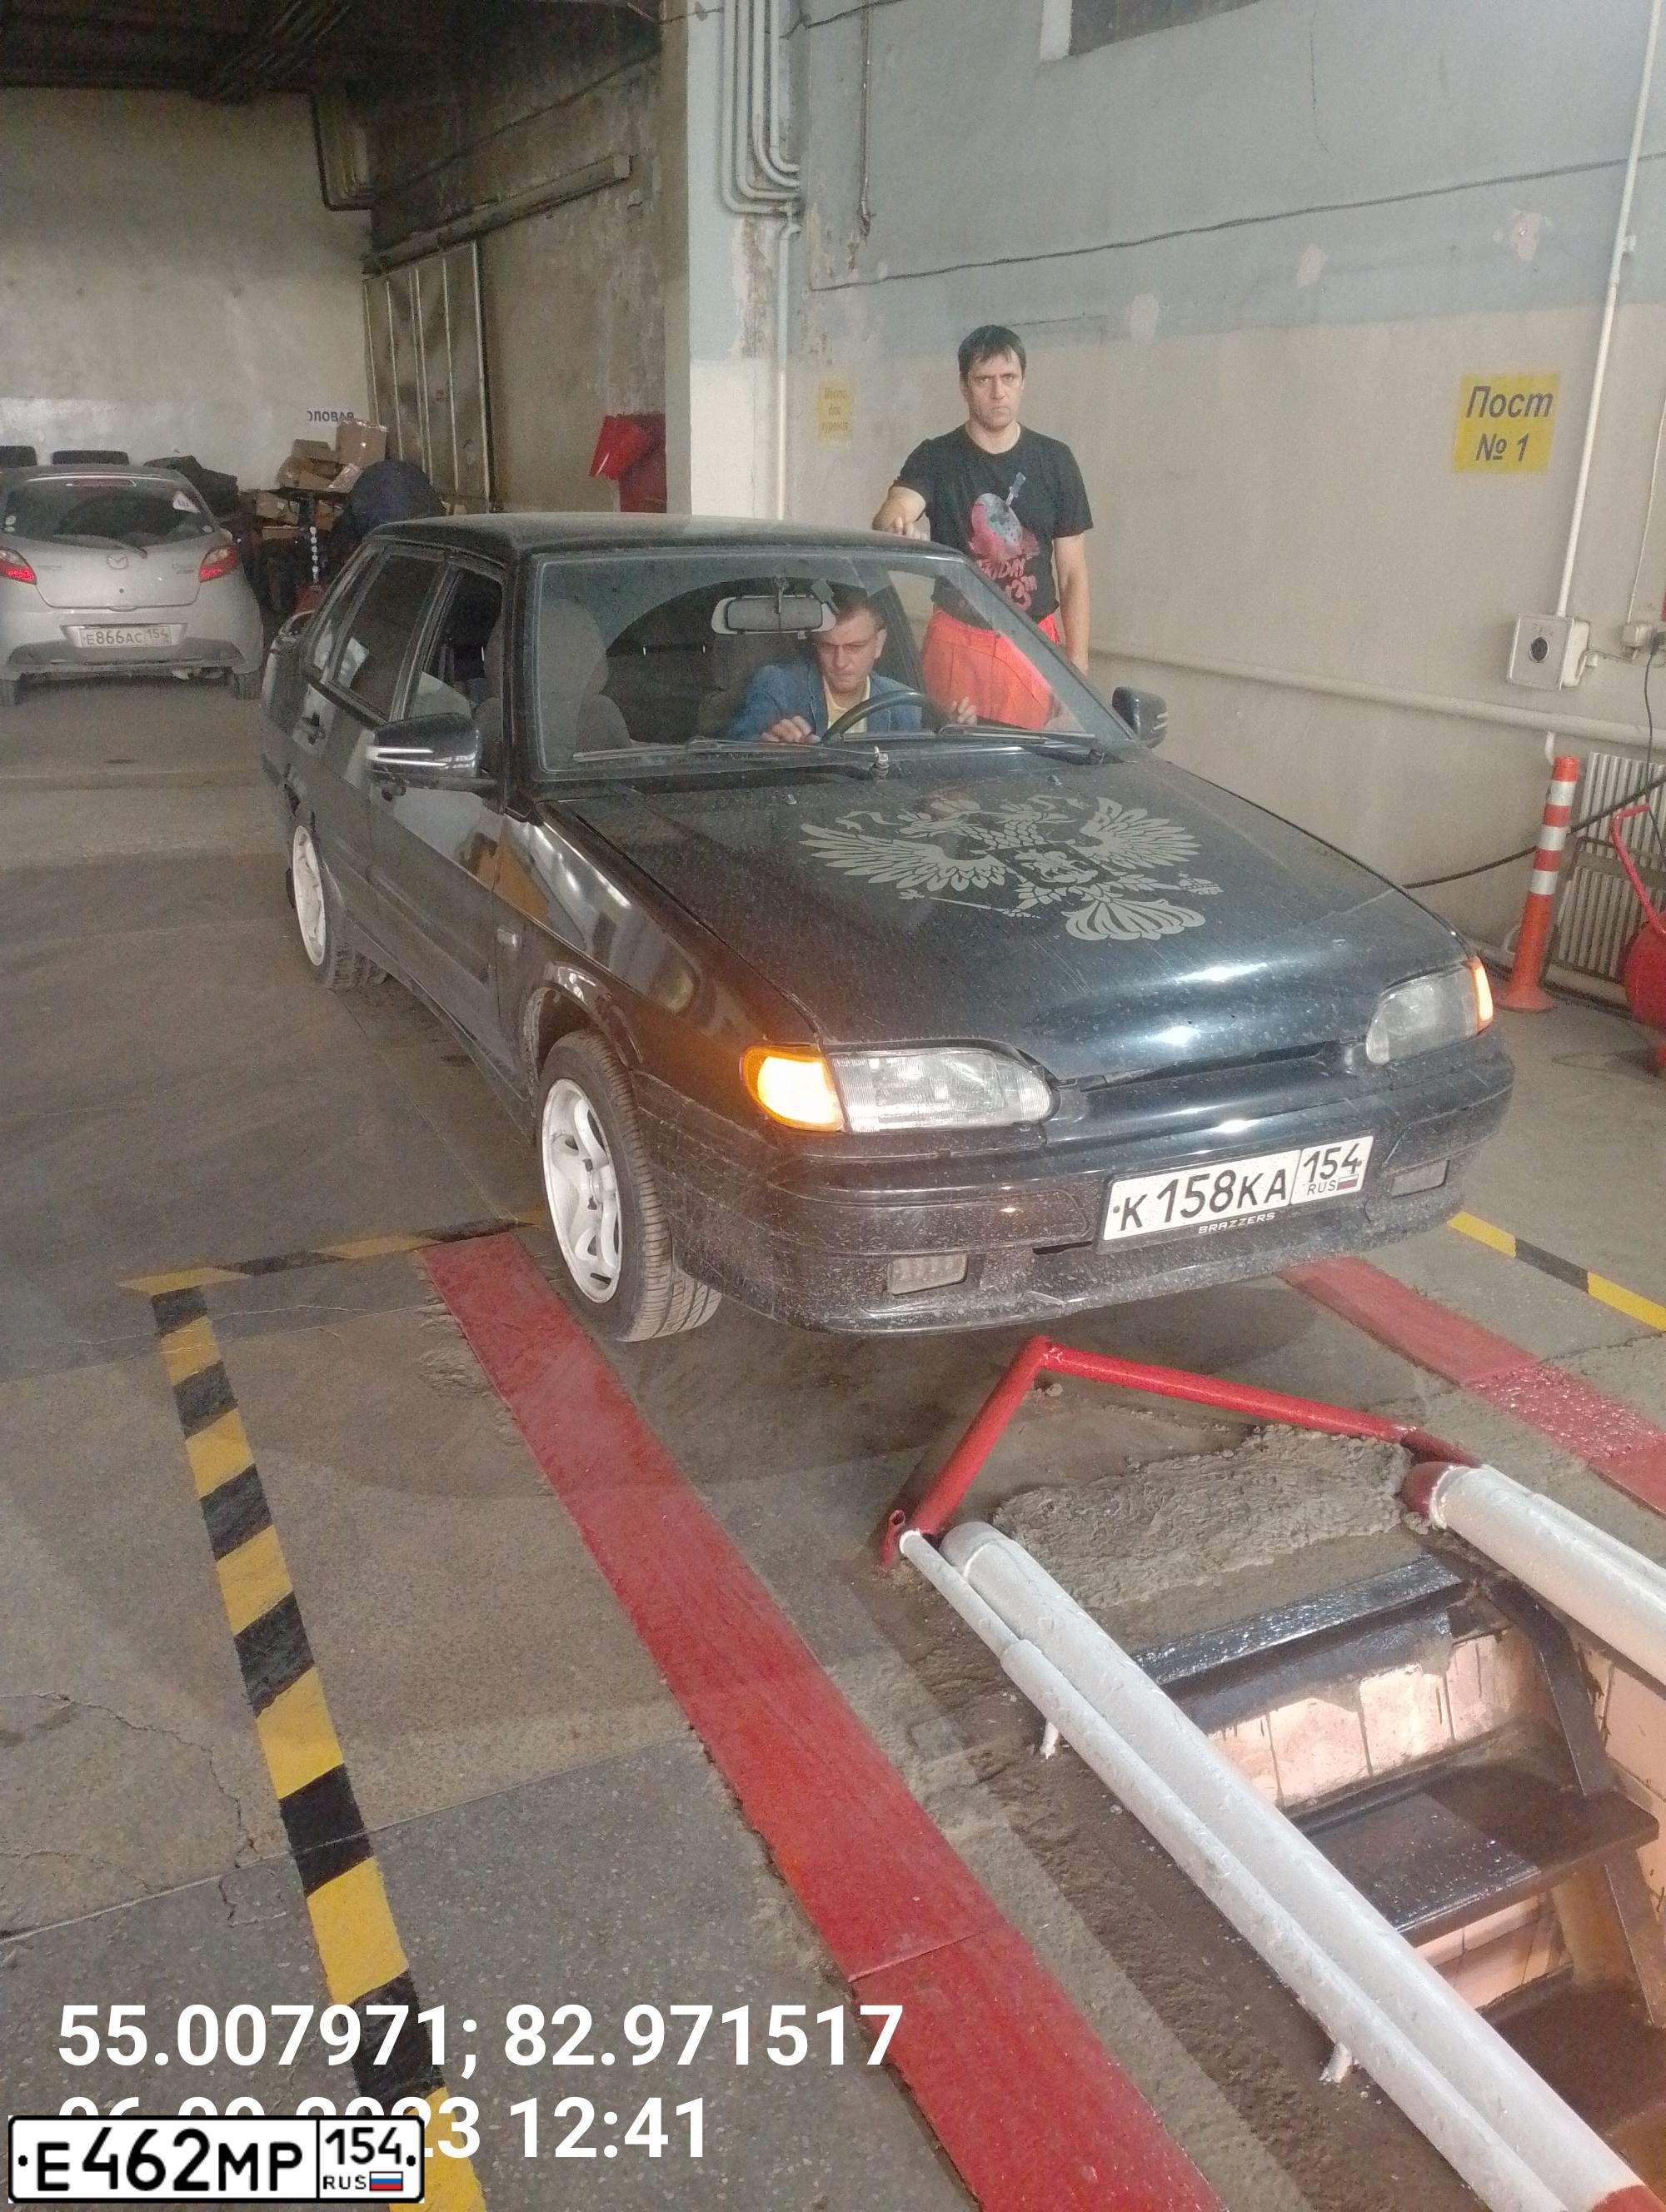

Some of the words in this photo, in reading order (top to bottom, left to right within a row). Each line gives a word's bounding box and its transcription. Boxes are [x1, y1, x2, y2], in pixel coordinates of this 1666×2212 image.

[1466, 386, 1554, 418] Пост
[1475, 433, 1508, 461] №
[1518, 433, 1529, 461] 1
[1120, 1168, 1287, 1232] К158КА
[1304, 1143, 1360, 1183] 154
[1307, 1179, 1337, 1195] RUS
[1198, 1213, 1276, 1235] BRAZZERS
